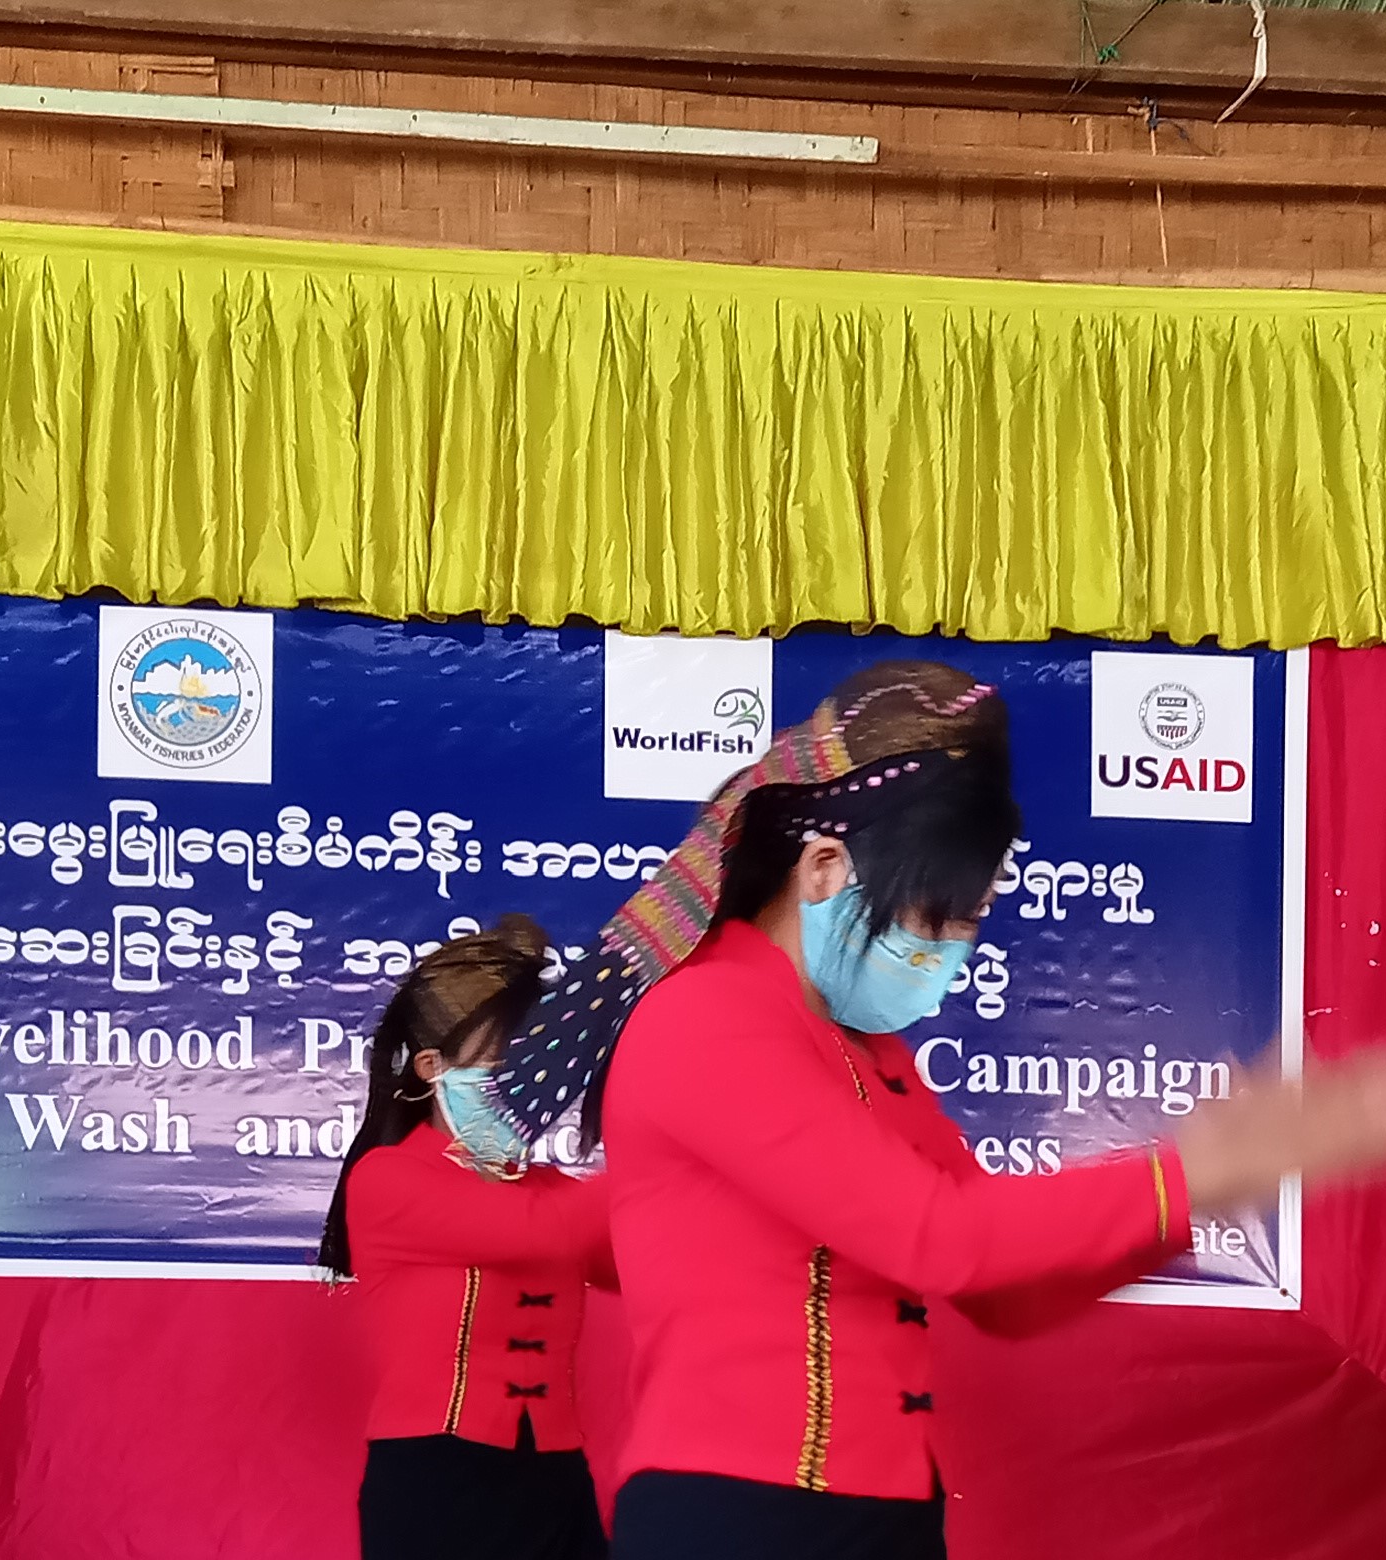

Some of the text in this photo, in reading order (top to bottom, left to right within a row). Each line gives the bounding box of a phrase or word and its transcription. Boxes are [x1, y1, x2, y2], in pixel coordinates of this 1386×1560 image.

[117, 702, 254, 762] MYANMAR FISHERIES FEDERATION
[612, 726, 754, 754] WorldFish
[1098, 753, 1247, 793] USAID
[297, 1017, 375, 1075] Pr
[914, 1036, 1232, 1115] Campaign
[6, 1093, 192, 1156] Wash
[234, 1104, 357, 1160] and
